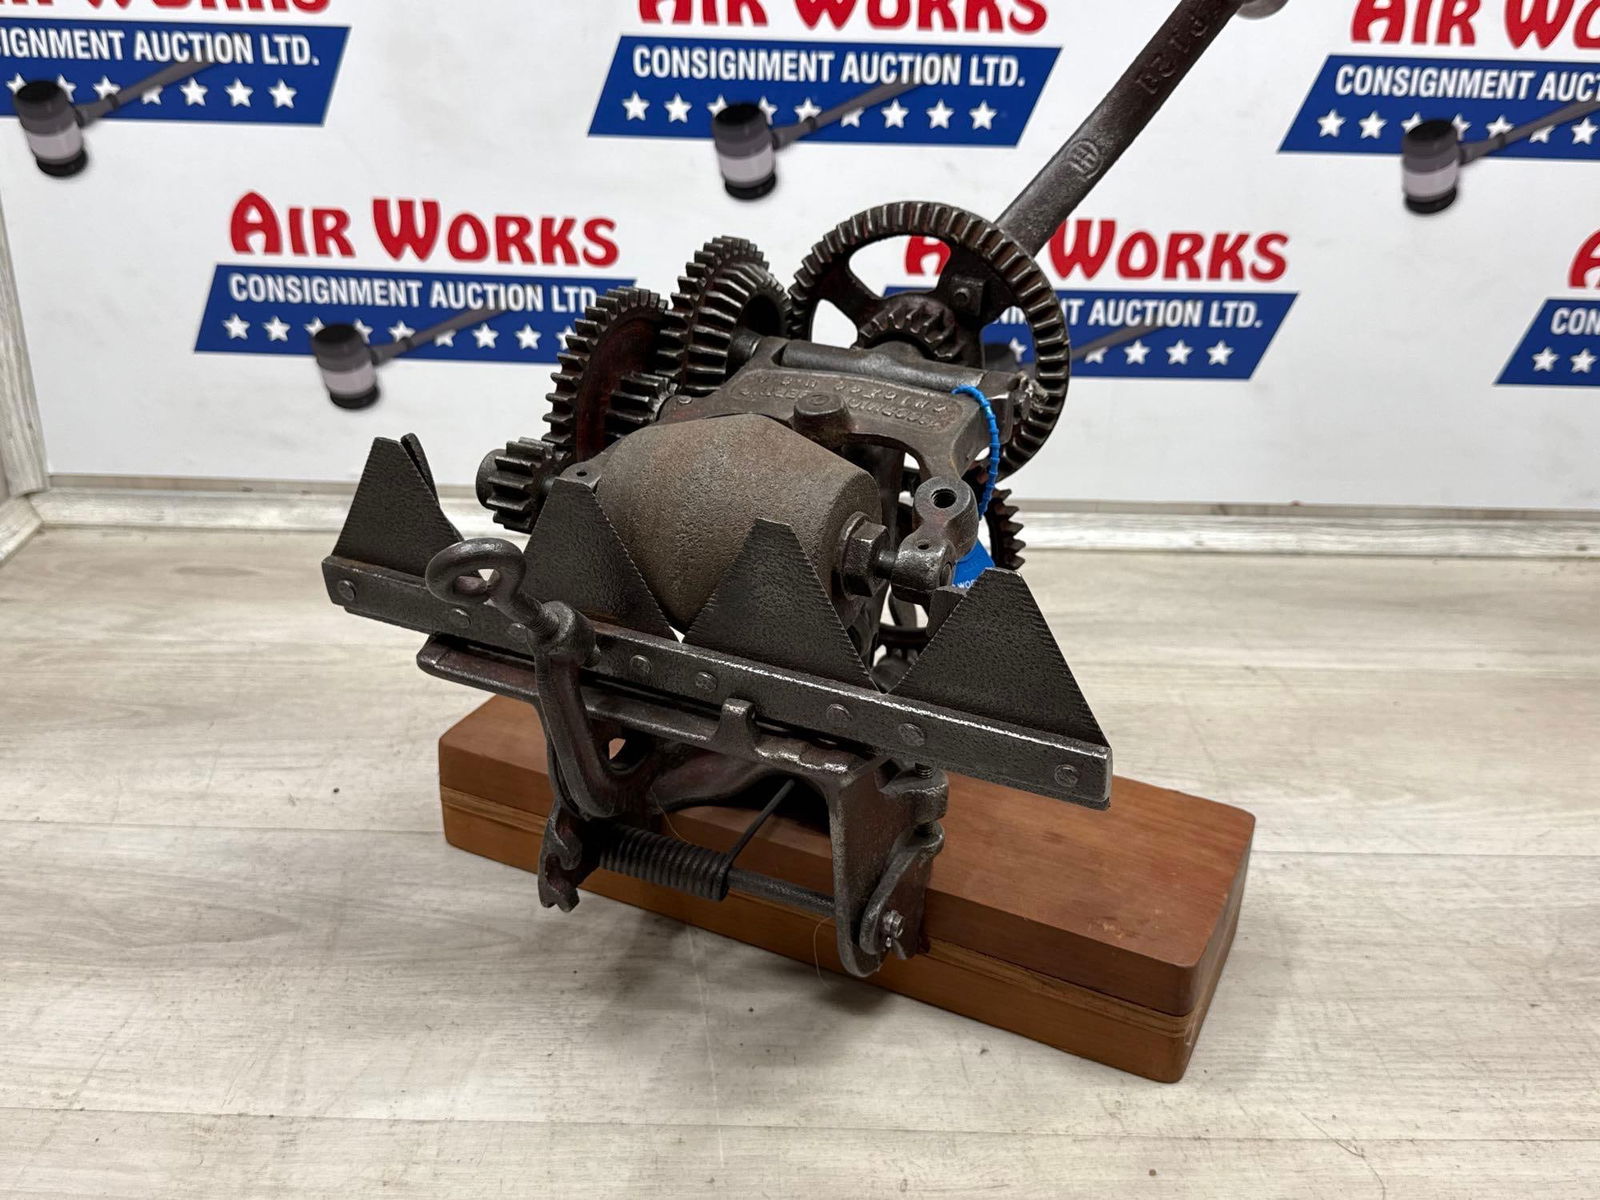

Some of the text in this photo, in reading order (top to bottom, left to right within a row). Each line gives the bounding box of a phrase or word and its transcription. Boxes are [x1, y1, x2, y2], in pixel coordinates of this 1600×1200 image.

[1350, 0, 1481, 46] AIR
[134, 29, 254, 64] AUCTION
[261, 33, 321, 66] LTD.
[632, 44, 1026, 88] CONSIGNMENT AUCTION LTD.
[1335, 63, 1535, 100] CONSIGNMENT
[229, 190, 621, 268] AIR WORKS
[1049, 218, 1290, 282] WORKS
[229, 272, 422, 307] CONSIGNMENT
[430, 279, 543, 312] AUCTION
[1088, 298, 1200, 328] AUCTION
[1209, 301, 1264, 329] LTD.
